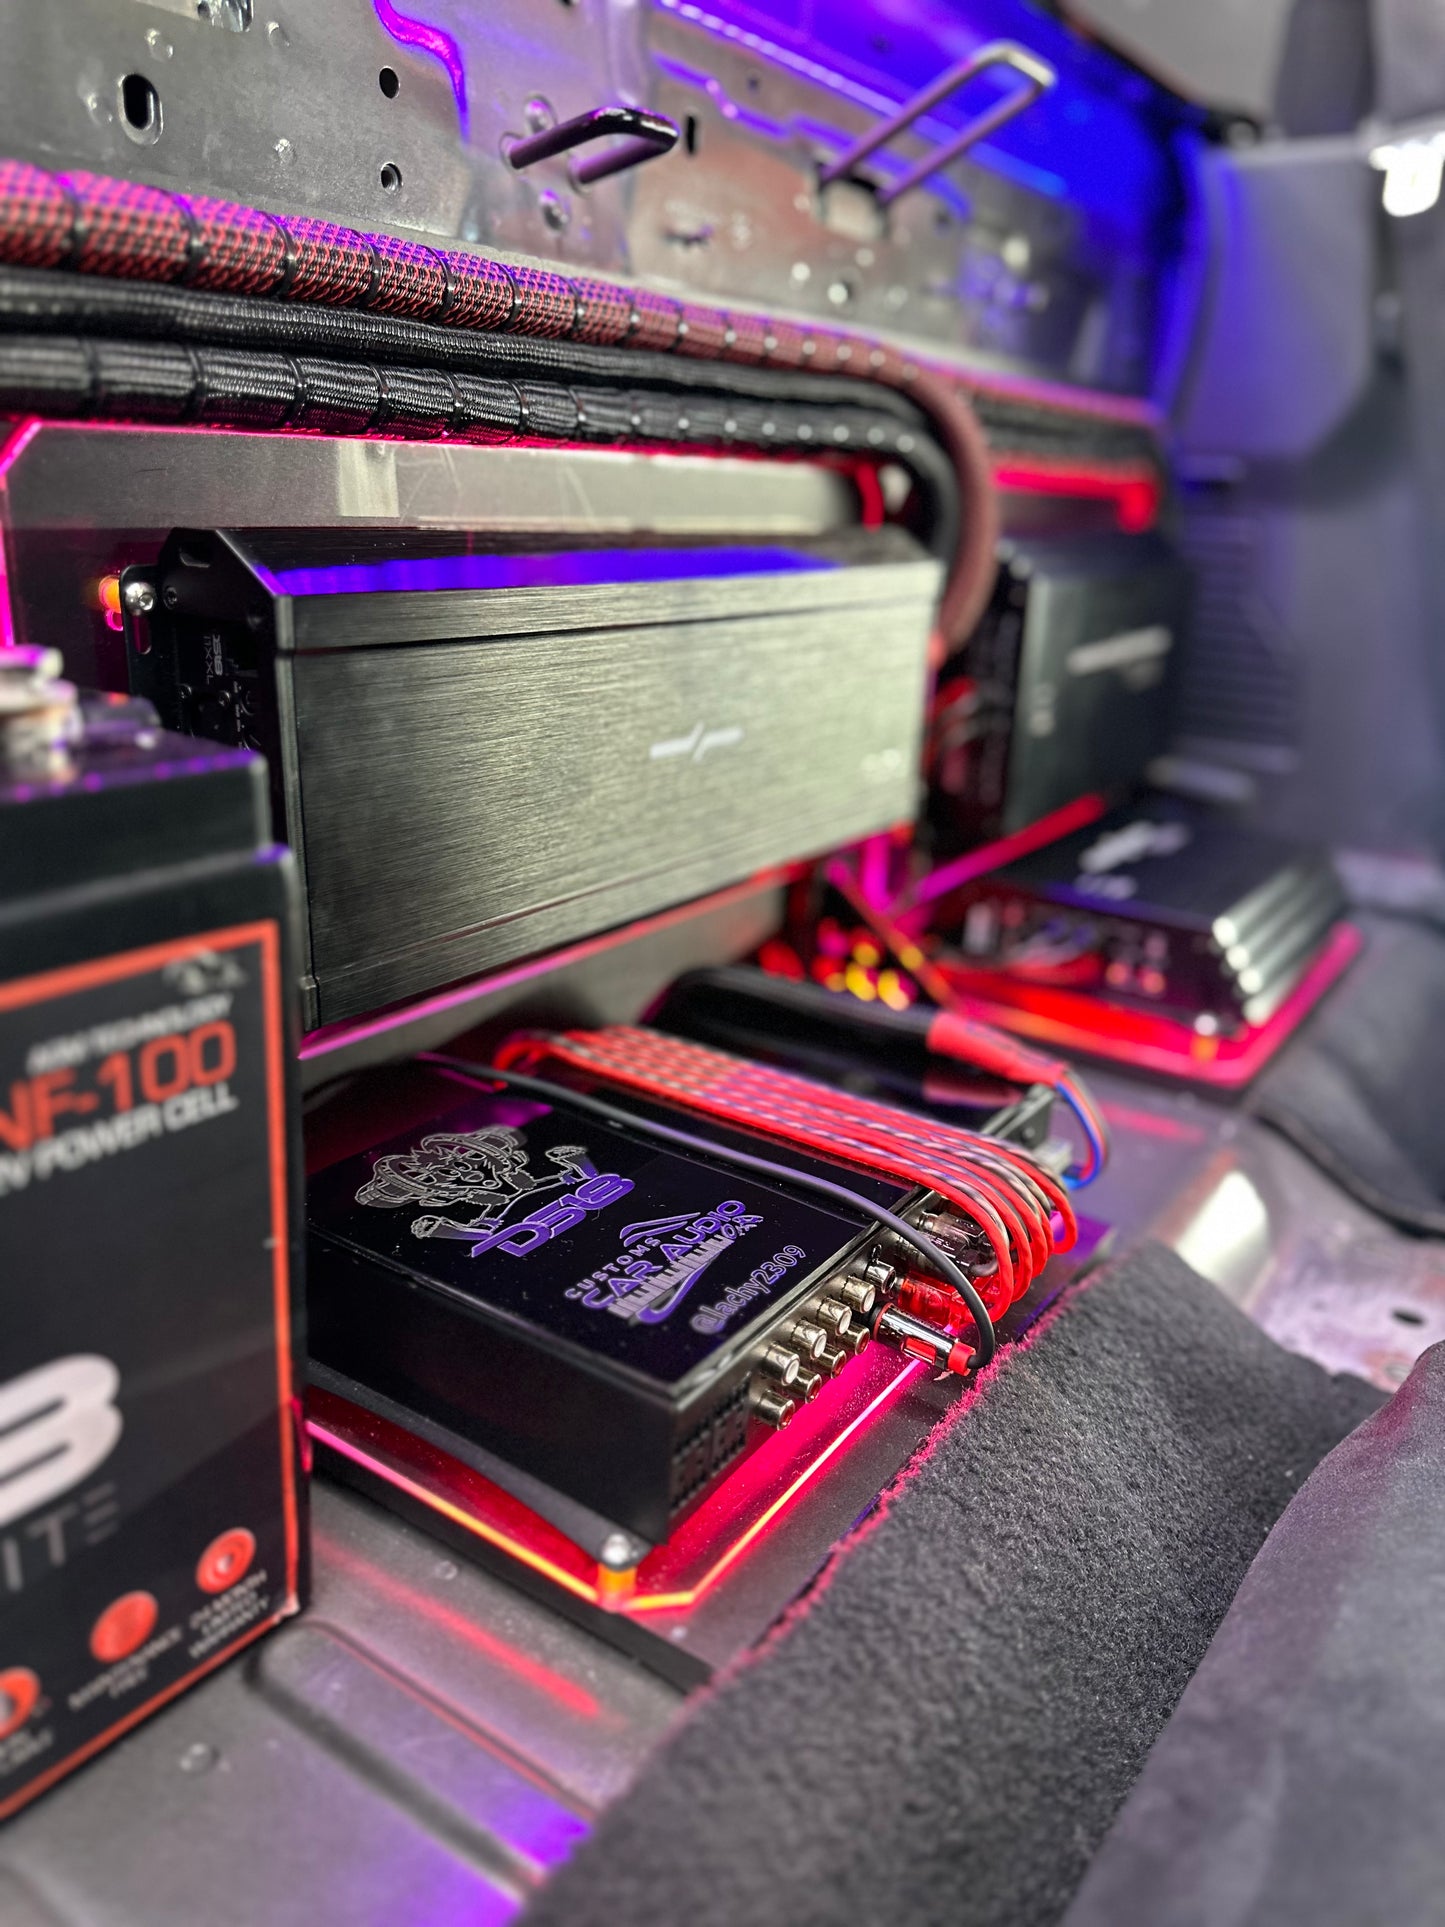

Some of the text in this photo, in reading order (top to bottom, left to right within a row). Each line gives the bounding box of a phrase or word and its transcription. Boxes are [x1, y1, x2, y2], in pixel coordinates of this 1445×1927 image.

[33, 1104, 163, 1179] POWER
[163, 1081, 240, 1133] CELL
[471, 1173, 636, 1258] DS18
[582, 1199, 747, 1309] CAR AUDIO
[564, 1236, 661, 1299] CUSTOMS
[690, 1244, 807, 1334] @lachy2309
